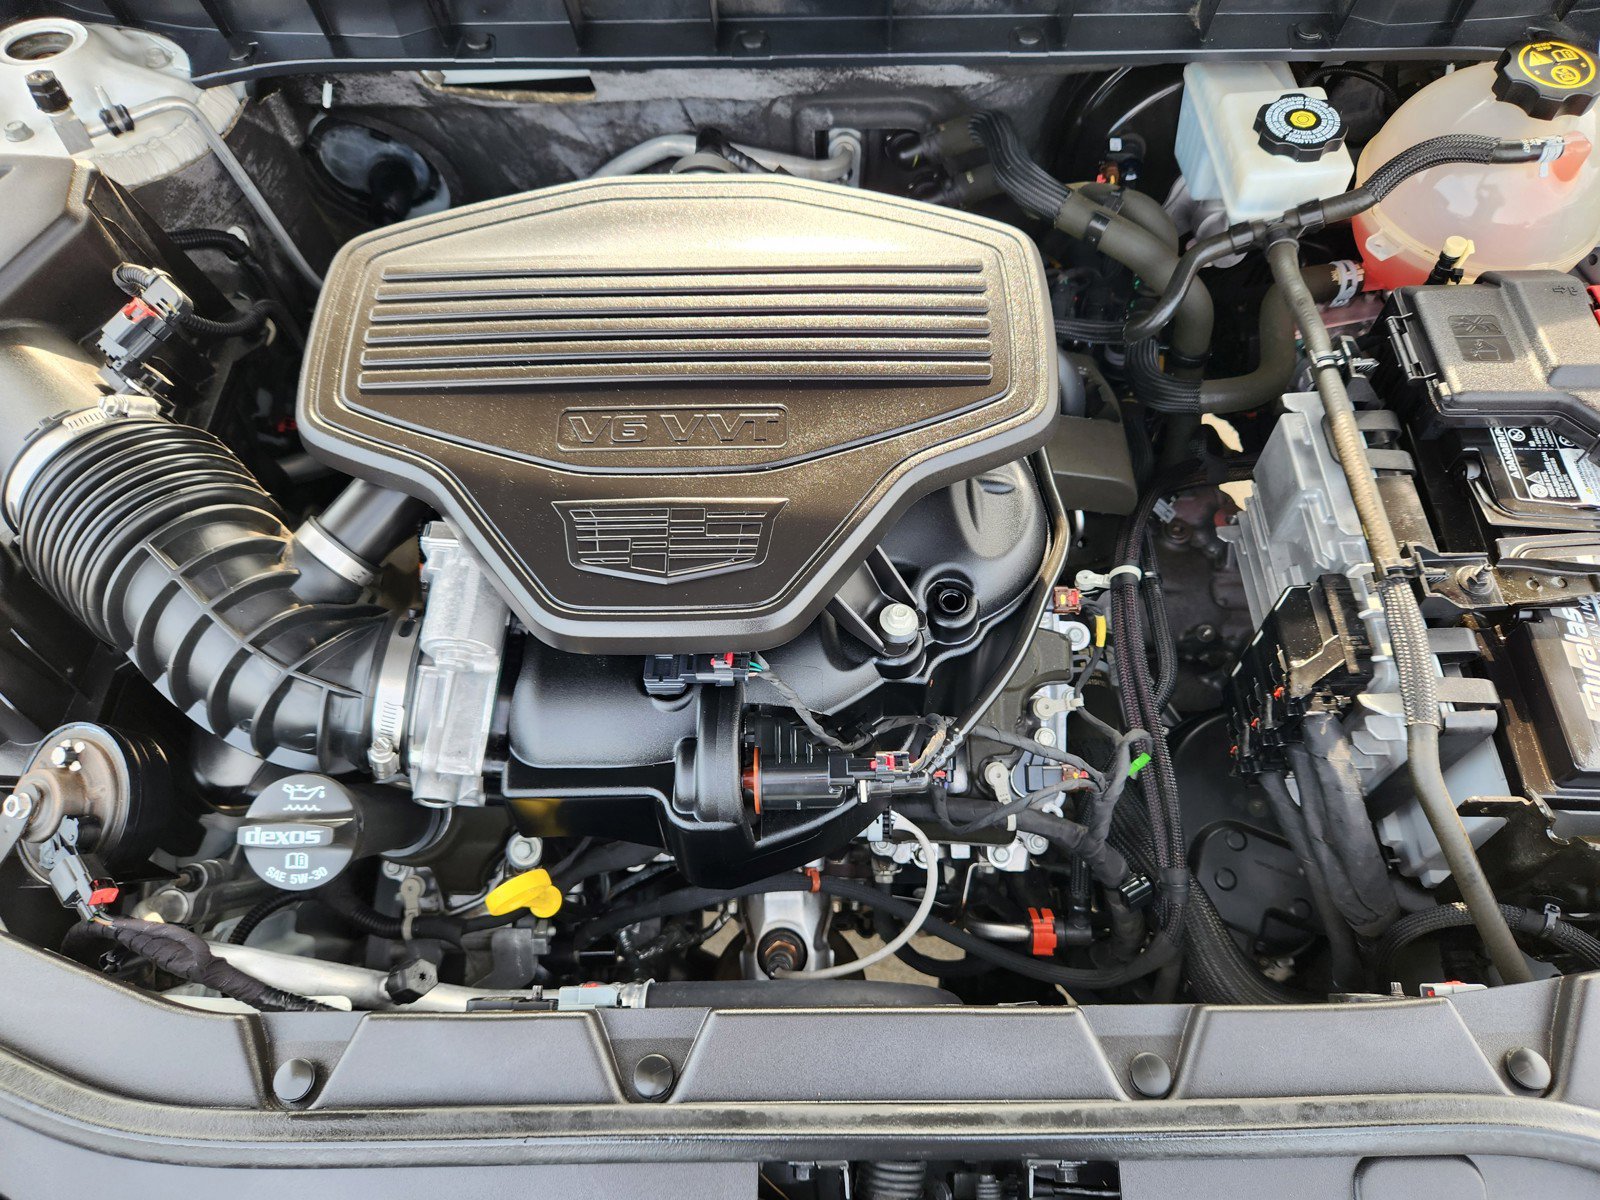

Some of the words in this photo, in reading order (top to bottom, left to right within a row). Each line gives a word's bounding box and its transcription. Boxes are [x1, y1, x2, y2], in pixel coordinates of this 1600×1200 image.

[568, 414, 648, 443] V6
[659, 412, 781, 442] VVT
[1494, 427, 1519, 472] DANGER/P
[245, 827, 324, 845] dexos
[265, 866, 287, 883] SAE
[288, 866, 329, 885] 5W-30
